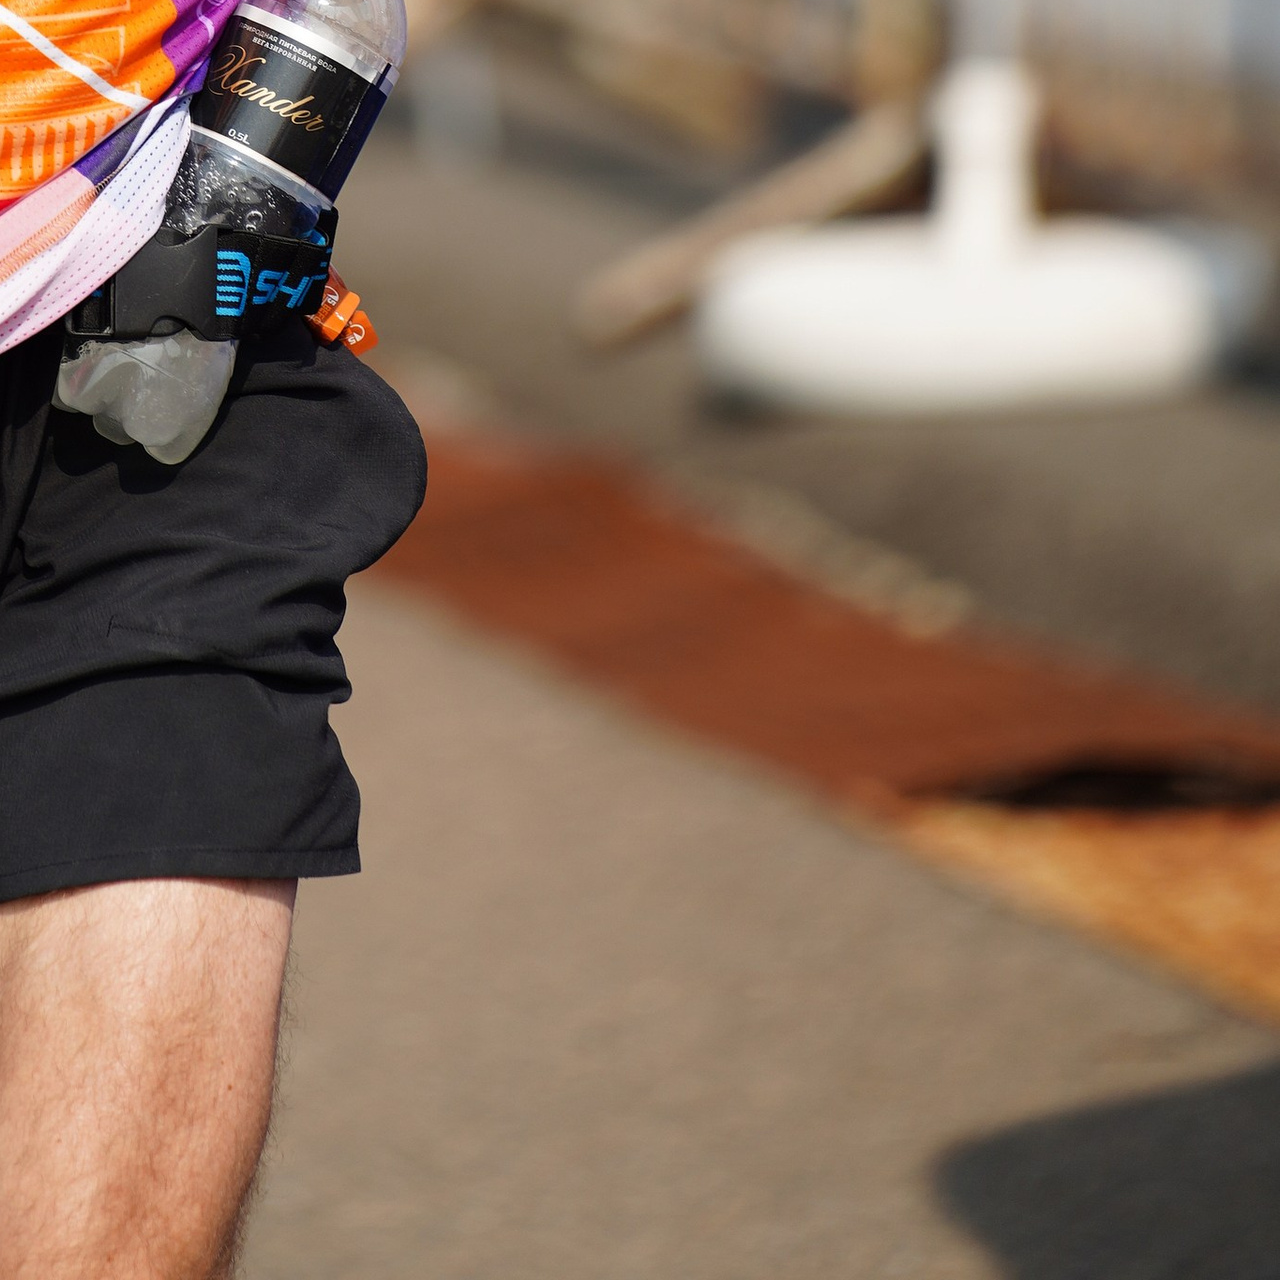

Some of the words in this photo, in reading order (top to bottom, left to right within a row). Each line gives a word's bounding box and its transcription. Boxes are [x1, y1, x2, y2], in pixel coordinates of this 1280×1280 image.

[239, 21, 278, 43] ПРИРОДНАЯ
[278, 38, 317, 61] ПИТЬЕВАЯ
[317, 58, 337, 74] ВОДА
[252, 36, 318, 73] НЕГАЗИРОВАННАЯ
[207, 44, 325, 132] Xander
[227, 128, 250, 145] 0,5L
